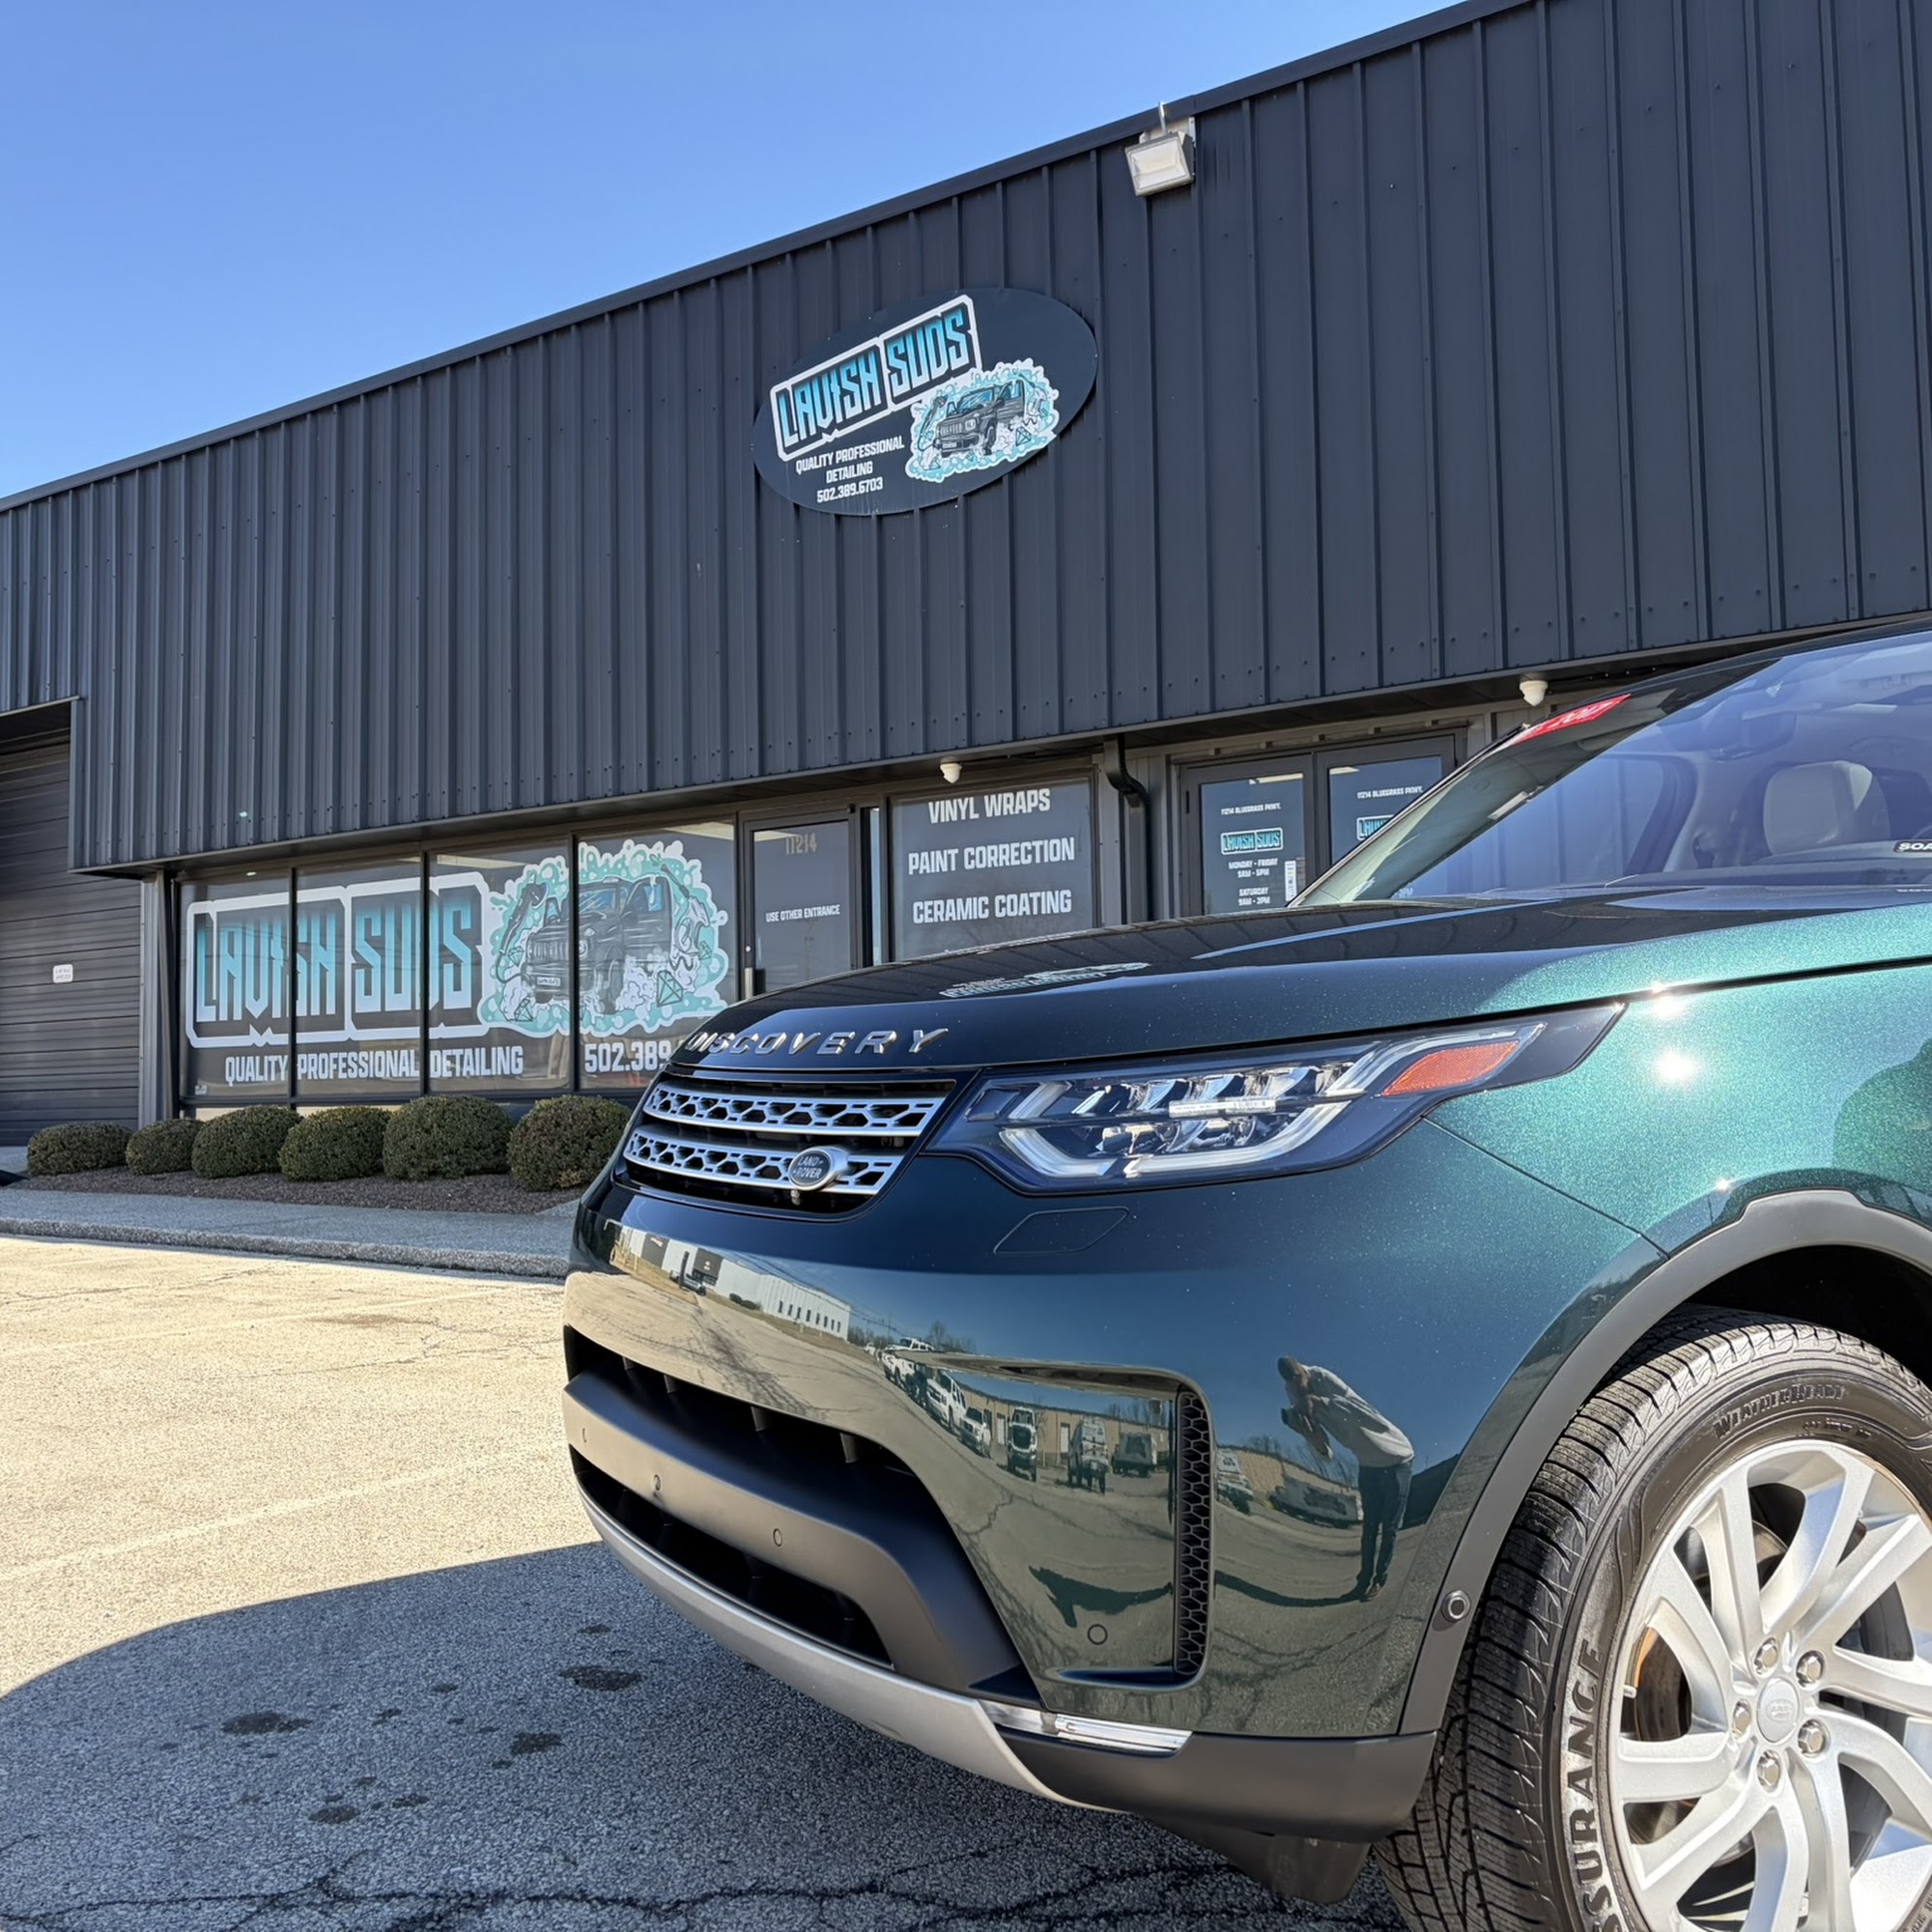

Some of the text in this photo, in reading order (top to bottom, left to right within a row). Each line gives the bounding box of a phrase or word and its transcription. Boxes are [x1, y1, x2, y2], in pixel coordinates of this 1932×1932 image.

[776, 307, 969, 447] LAVISH SUDS
[796, 436, 905, 475] QUALITY PROFESSIONAL
[826, 461, 873, 484] DETAILING
[817, 476, 883, 503] 502.389.6703
[928, 788, 1051, 824] VINYL WRAPS
[785, 832, 818, 856] 11214
[908, 838, 1075, 875] PAINT CORRECTION
[765, 904, 840, 923] USE OTHER ENTRANCE
[913, 889, 1072, 924] CERAMIC COATING
[355, 898, 472, 1013] SUDS
[684, 1027, 950, 1055] DISCOVERY
[225, 1045, 524, 1087] QUALITY PROFESSIONAL DETAILING
[794, 1166, 823, 1179] ROVER
[797, 1155, 820, 1167] LAND
